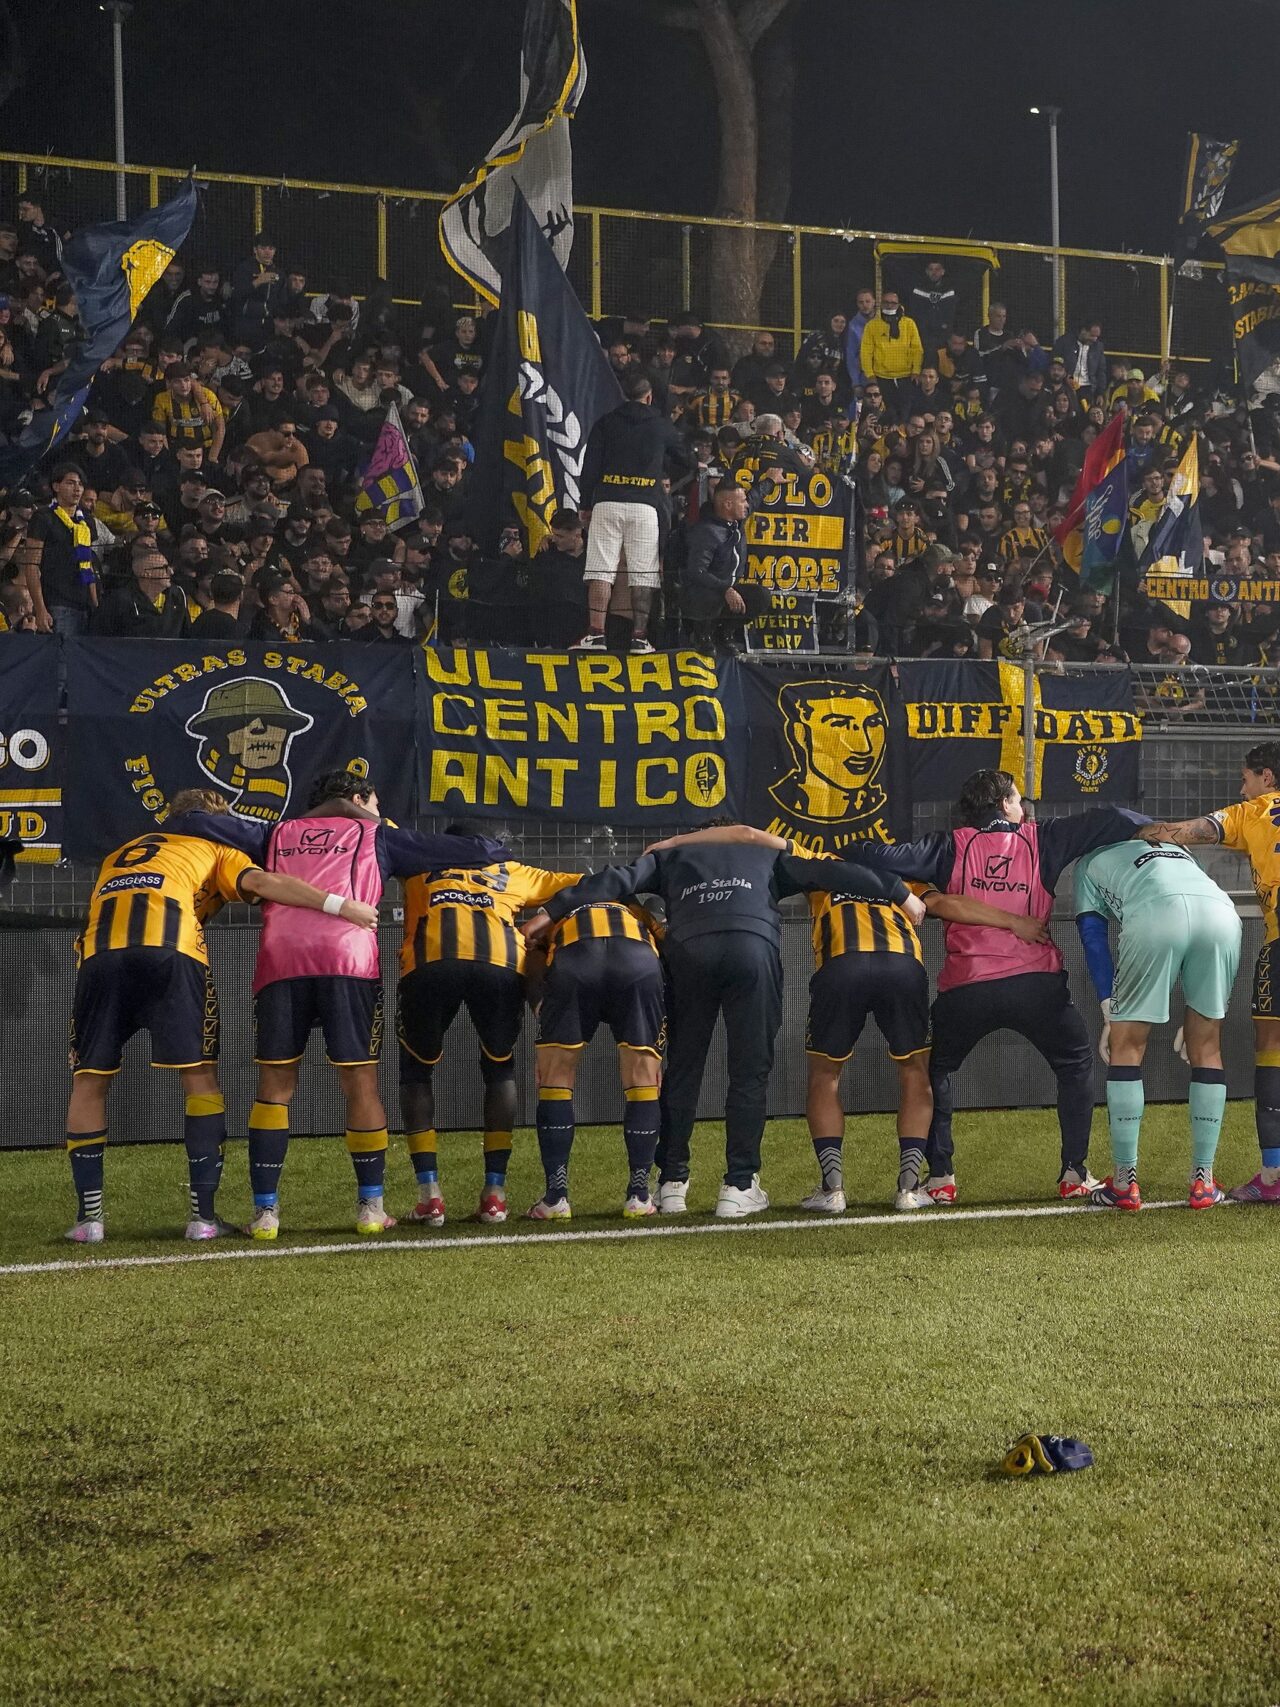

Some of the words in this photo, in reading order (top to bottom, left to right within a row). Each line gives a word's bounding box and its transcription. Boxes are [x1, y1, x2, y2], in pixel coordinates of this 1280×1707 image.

[735, 468, 833, 508] SOLO
[754, 516, 809, 543] PER
[738, 553, 842, 594] MORE
[1147, 577, 1209, 600] CENTRO
[771, 595, 797, 610] NO
[129, 648, 247, 714] ULTRAS
[263, 651, 369, 717] STABIA
[424, 646, 720, 693] ULTRAS
[432, 692, 726, 745] CENTRO
[917, 704, 1137, 741] DIFFIDATI
[429, 749, 726, 808] ANTICO
[765, 816, 825, 853] NINO
[681, 881, 708, 899] Juve
[711, 877, 752, 891] Stabia
[697, 890, 733, 905] 1907
[969, 877, 1031, 895] GIVOVA
